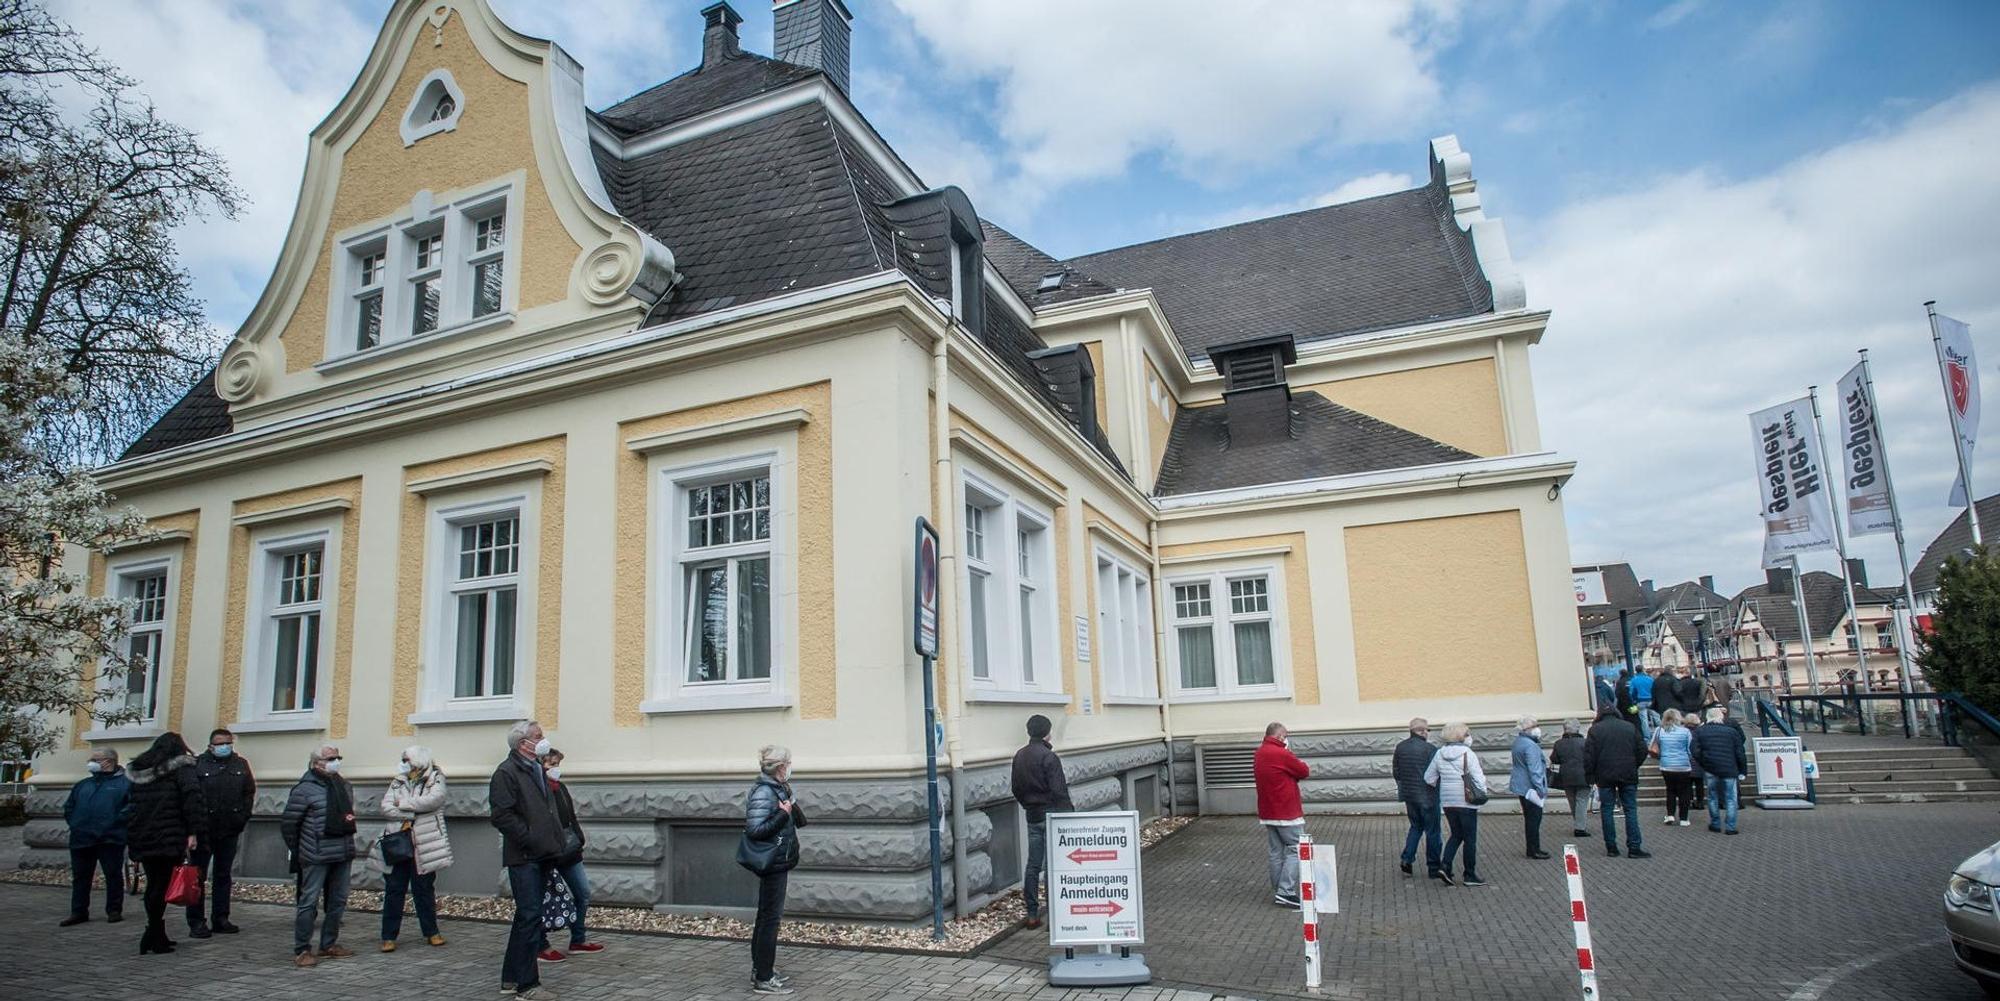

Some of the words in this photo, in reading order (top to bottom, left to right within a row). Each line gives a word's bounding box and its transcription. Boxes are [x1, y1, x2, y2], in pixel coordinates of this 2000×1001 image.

[1102, 825, 1126, 834] Zugang
[1058, 834, 1128, 848] Anmeldung
[1060, 873, 1128, 886] Haupteingang
[1060, 886, 1129, 900] Anmeldung
